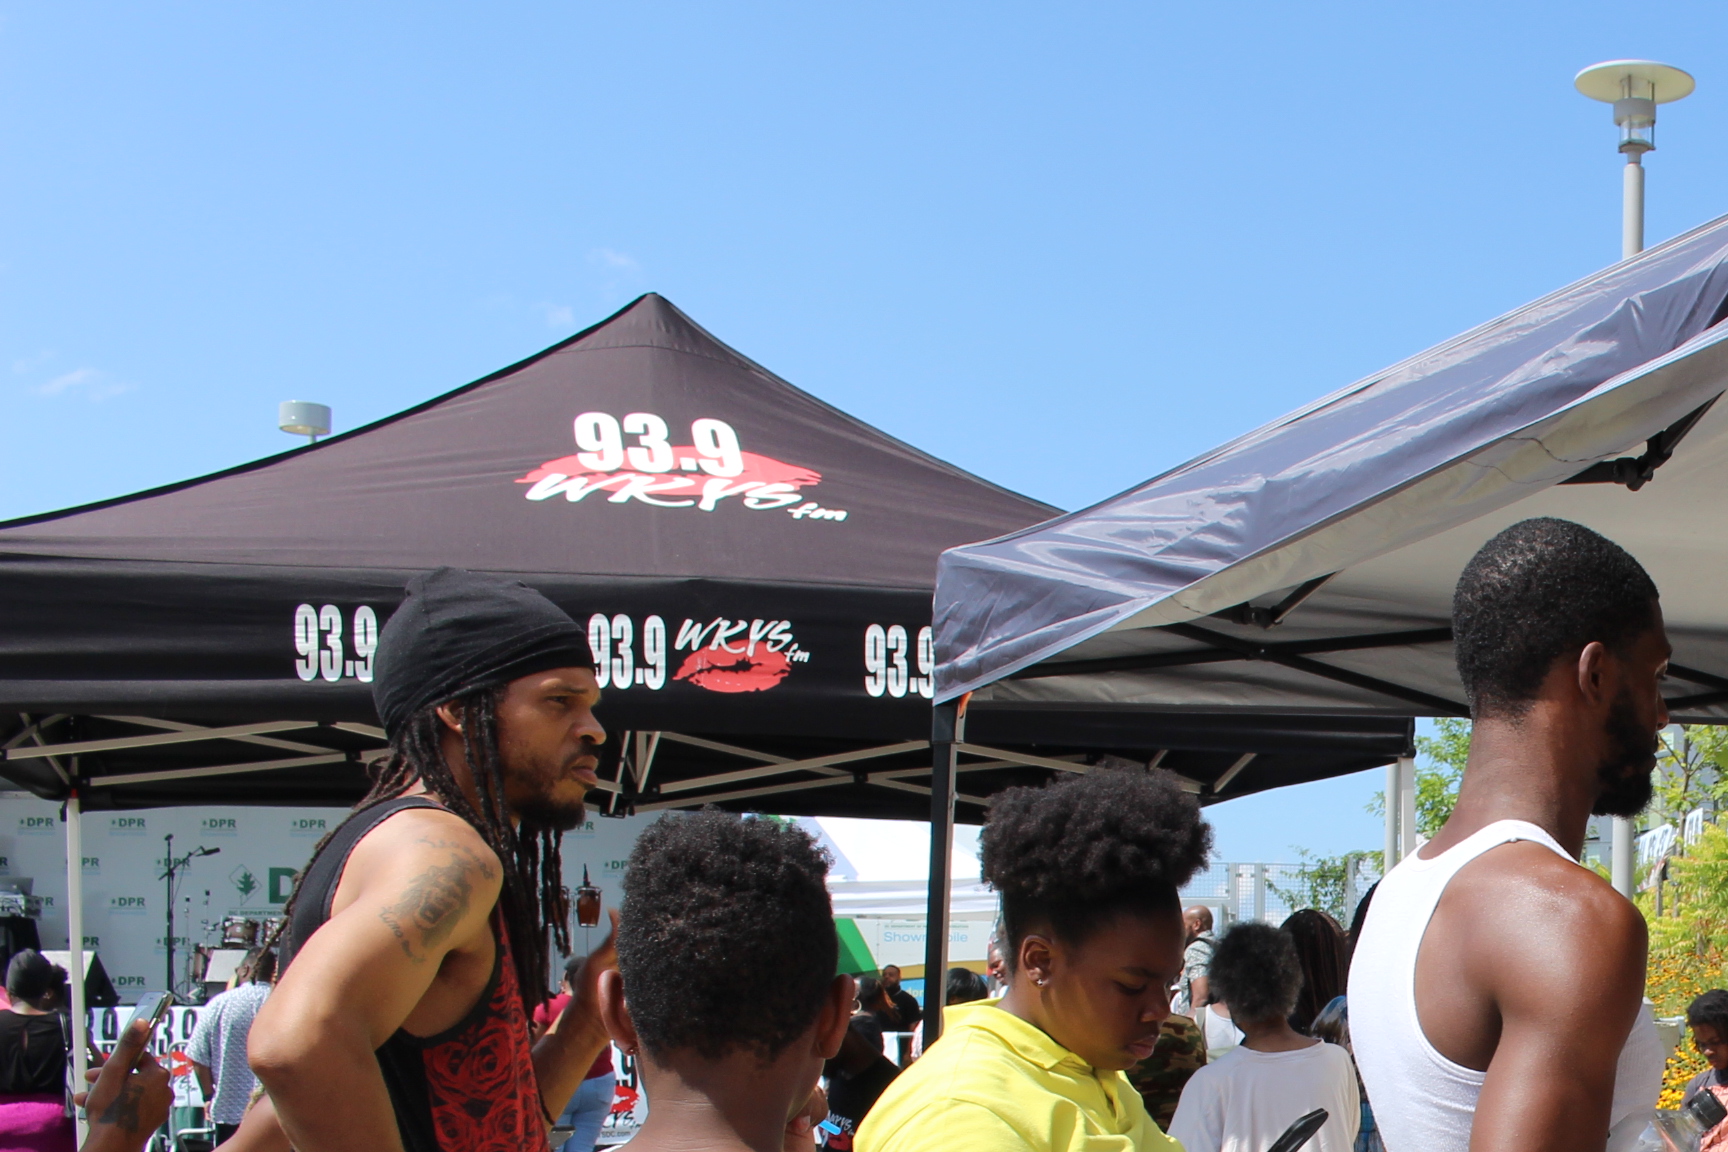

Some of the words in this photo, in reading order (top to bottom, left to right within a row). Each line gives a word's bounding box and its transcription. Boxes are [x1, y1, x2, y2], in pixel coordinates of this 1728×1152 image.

[573, 412, 745, 478] 93.9
[525, 473, 804, 512] WKYS
[786, 502, 848, 522] fm
[294, 604, 378, 682] 93.9
[588, 614, 666, 690] 93.9
[673, 617, 793, 657] WKYS
[864, 624, 935, 698] 93.9
[26, 817, 54, 828] DPR
[117, 817, 146, 828] DPR
[209, 818, 237, 829] DPR
[299, 818, 327, 829] DPR
[117, 897, 146, 907] DPR
[117, 975, 146, 986] DPR
